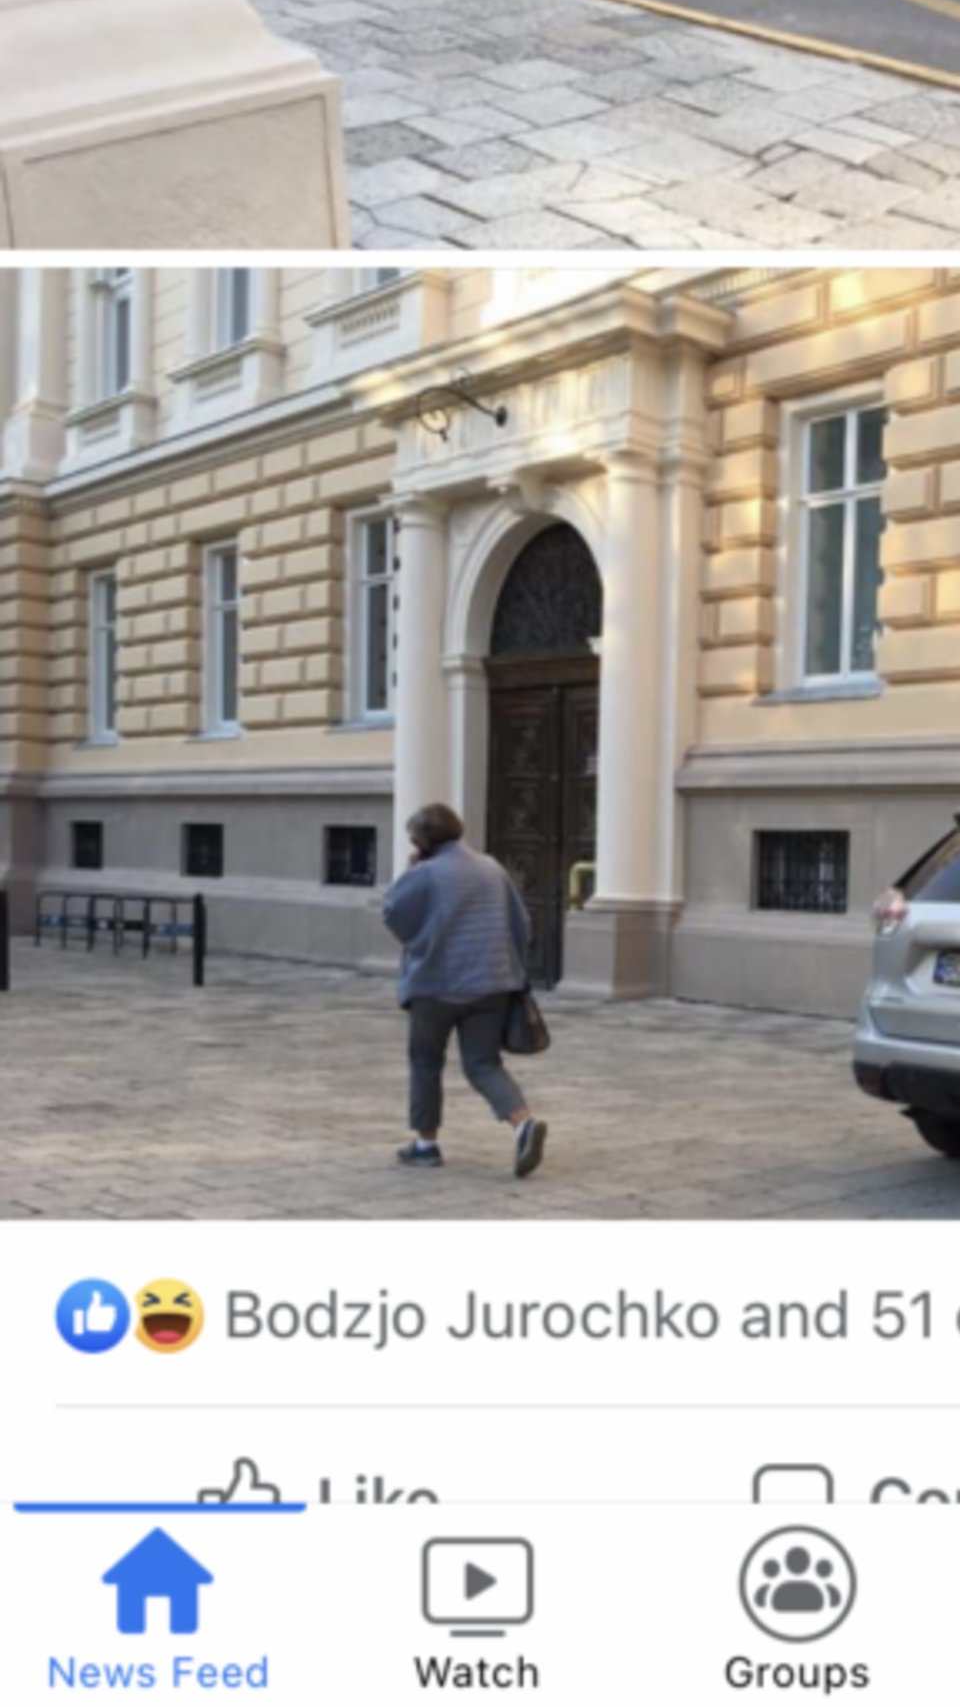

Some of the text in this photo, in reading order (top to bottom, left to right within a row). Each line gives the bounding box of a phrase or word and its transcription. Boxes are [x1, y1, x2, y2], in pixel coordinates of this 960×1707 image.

[228, 1290, 425, 1350] Bodzjo
[448, 1290, 719, 1339] Jurochko
[742, 1290, 847, 1339] and
[874, 1290, 930, 1339] 51
[50, 1657, 267, 1688] News Feed
[414, 1655, 538, 1688] Watch
[725, 1656, 870, 1695] Groups
